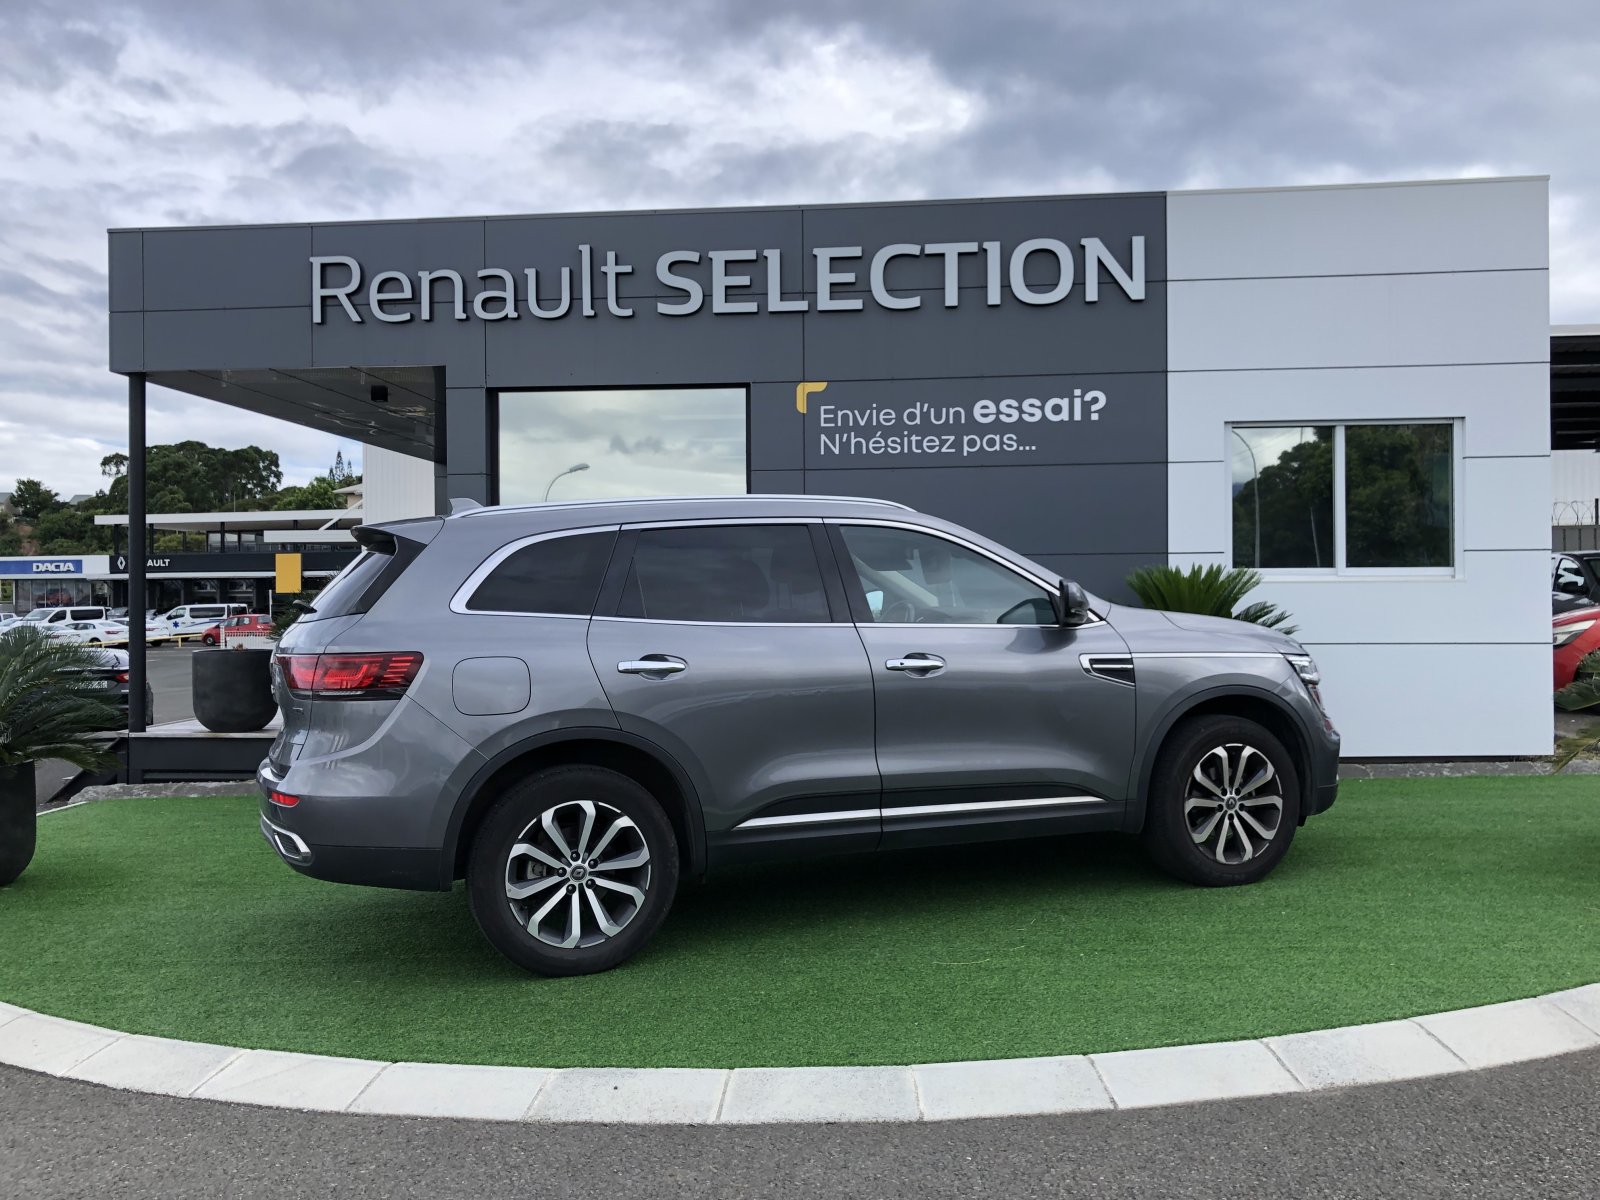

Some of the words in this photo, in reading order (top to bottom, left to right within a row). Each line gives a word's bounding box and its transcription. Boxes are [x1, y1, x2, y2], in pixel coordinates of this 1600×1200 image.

[310, 244, 634, 325] Renault
[655, 235, 1146, 316] SELECTION
[819, 403, 896, 427] Envie
[903, 402, 966, 425] d'un
[973, 388, 1107, 423] essai?
[819, 431, 956, 455] N'hésitez
[963, 433, 1037, 456] pas...
[32, 562, 75, 572] DACIA
[146, 558, 171, 567] AULT
